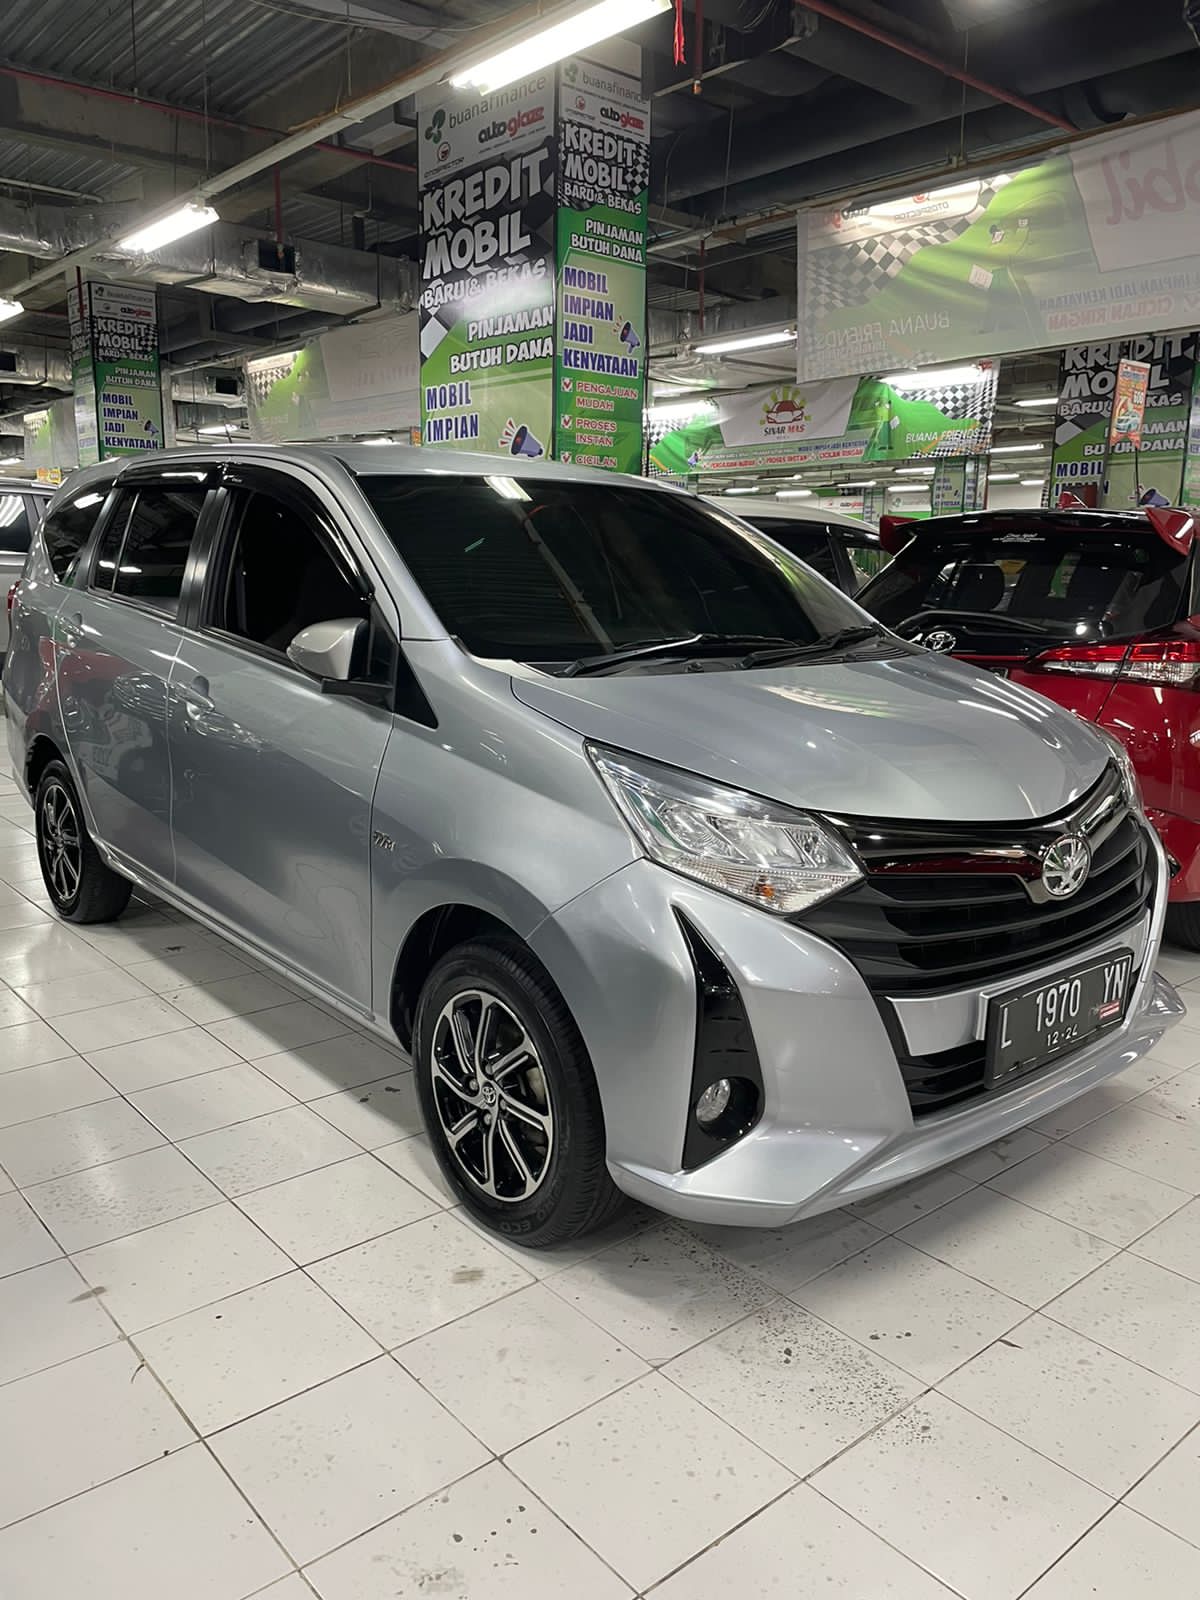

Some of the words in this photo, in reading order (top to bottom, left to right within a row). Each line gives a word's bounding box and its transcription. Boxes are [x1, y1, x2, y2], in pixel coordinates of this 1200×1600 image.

[564, 123, 635, 166] KREDIT
[564, 154, 628, 192] MOBIL
[423, 148, 549, 231] KREDIT
[564, 182, 594, 202] BARU
[594, 191, 606, 204] &
[607, 194, 642, 215] BEKAS
[423, 211, 531, 279] MOBIL
[586, 219, 643, 245] PINJAMAN
[571, 234, 610, 255] BUTUH
[612, 243, 643, 263] DANA
[424, 280, 465, 309] BARU
[469, 278, 482, 296] &
[486, 258, 546, 288] BEKAS
[564, 267, 609, 293] MOBIL
[564, 294, 614, 321] IMPIAN
[97, 319, 144, 337] KREDIT
[467, 305, 553, 342] PINJAMAN
[563, 321, 593, 344] JADI
[99, 333, 142, 351] MOBIL
[1063, 336, 1190, 371] KREDIT
[450, 345, 502, 374] BUTUH
[506, 337, 553, 364] DANA
[563, 349, 639, 377] KENYATAAN
[576, 382, 638, 399] PENGAJUAN
[1060, 364, 1169, 399] MOL
[102, 393, 133, 406] MOBIL
[426, 382, 472, 410] MOBIL
[576, 397, 614, 410] MUDAH
[1059, 400, 1103, 416] BARU
[103, 407, 139, 420] IMPIAN
[576, 418, 617, 431] PROSES
[104, 421, 125, 433] JADI
[427, 414, 479, 443] IMPIAN
[905, 431, 938, 443] BUANA
[104, 436, 158, 450] KENYATAAN
[576, 434, 613, 447] INSTAN
[1084, 441, 1136, 456] BUUH
[1140, 438, 1185, 452] DANA
[576, 455, 617, 467] CICILAN
[1056, 461, 1103, 477] MOBIL
[1001, 1007, 1012, 1049] L
[1036, 979, 1081, 1032] 1970
[1103, 961, 1126, 1003] YN
